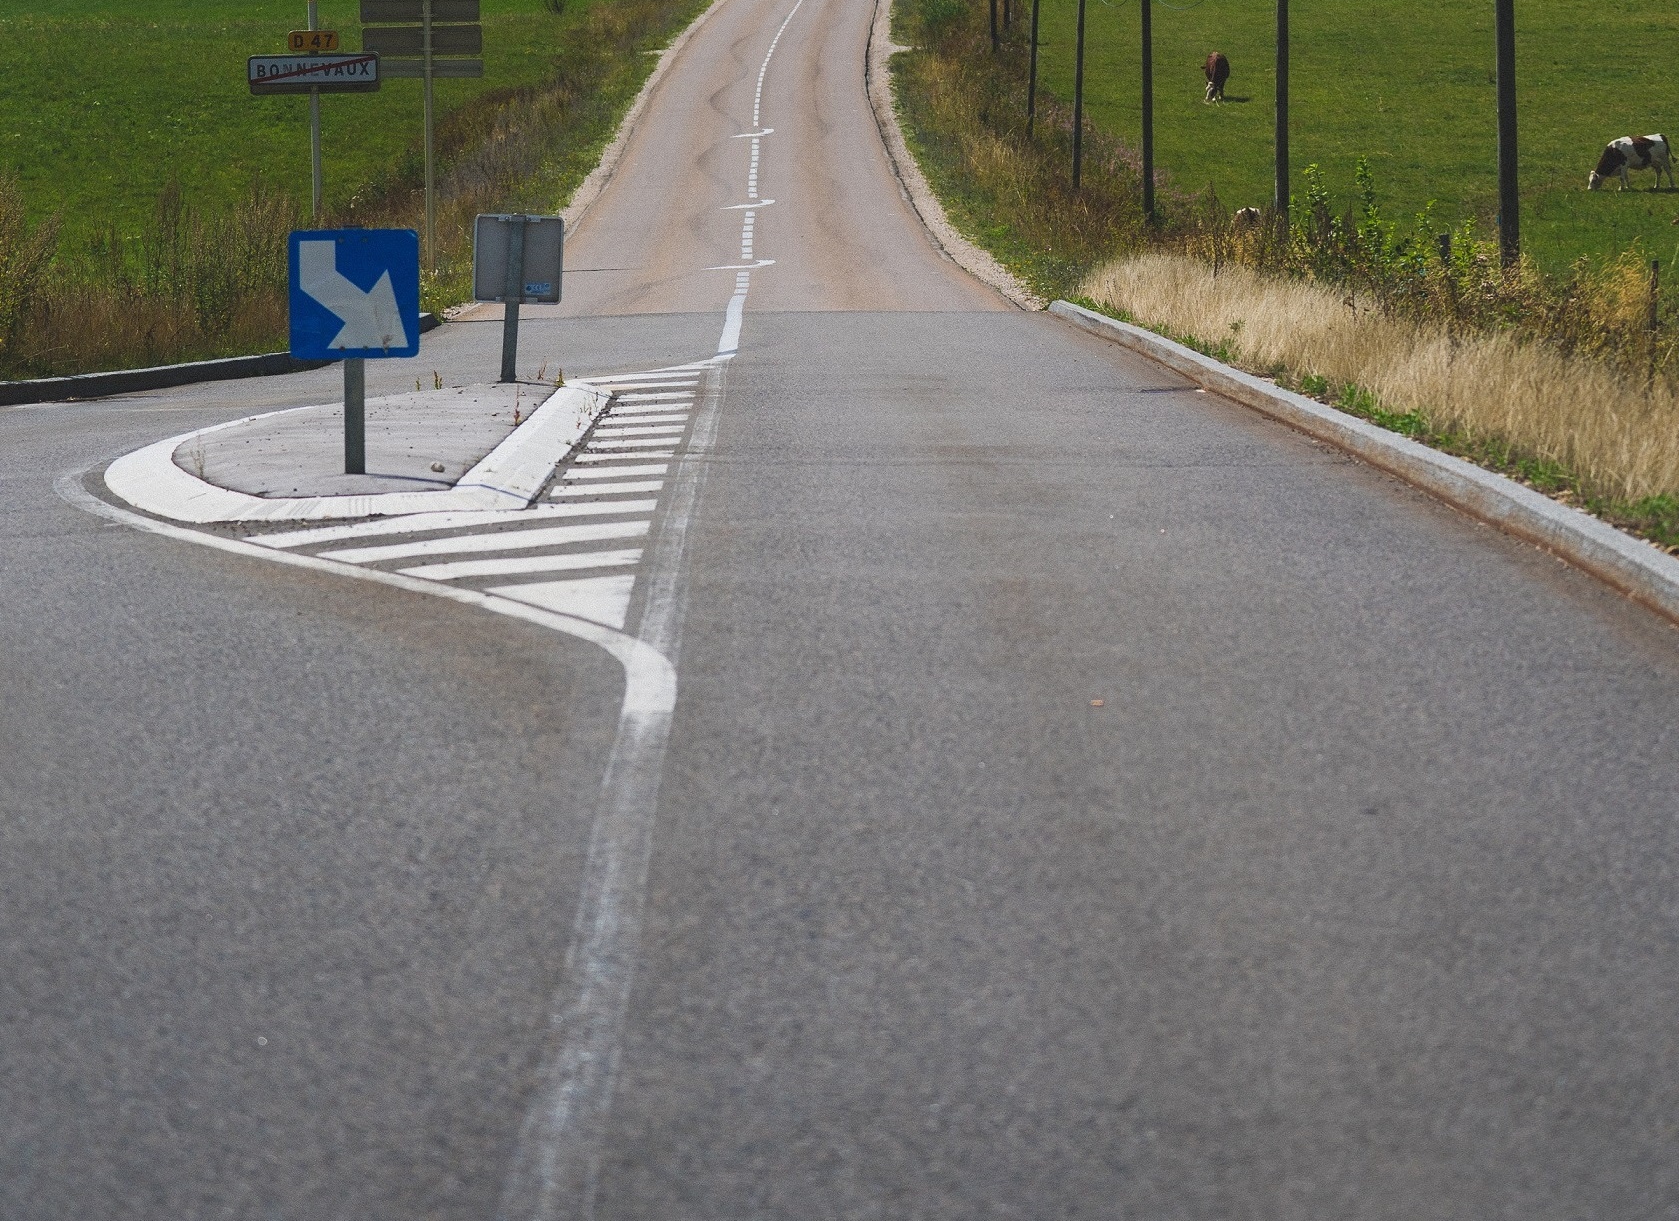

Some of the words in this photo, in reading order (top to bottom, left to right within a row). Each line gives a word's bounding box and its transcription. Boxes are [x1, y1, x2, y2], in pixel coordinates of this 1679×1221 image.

[293, 34, 304, 48] D
[310, 34, 334, 48] 47
[256, 60, 370, 78] BONNEVAUX
